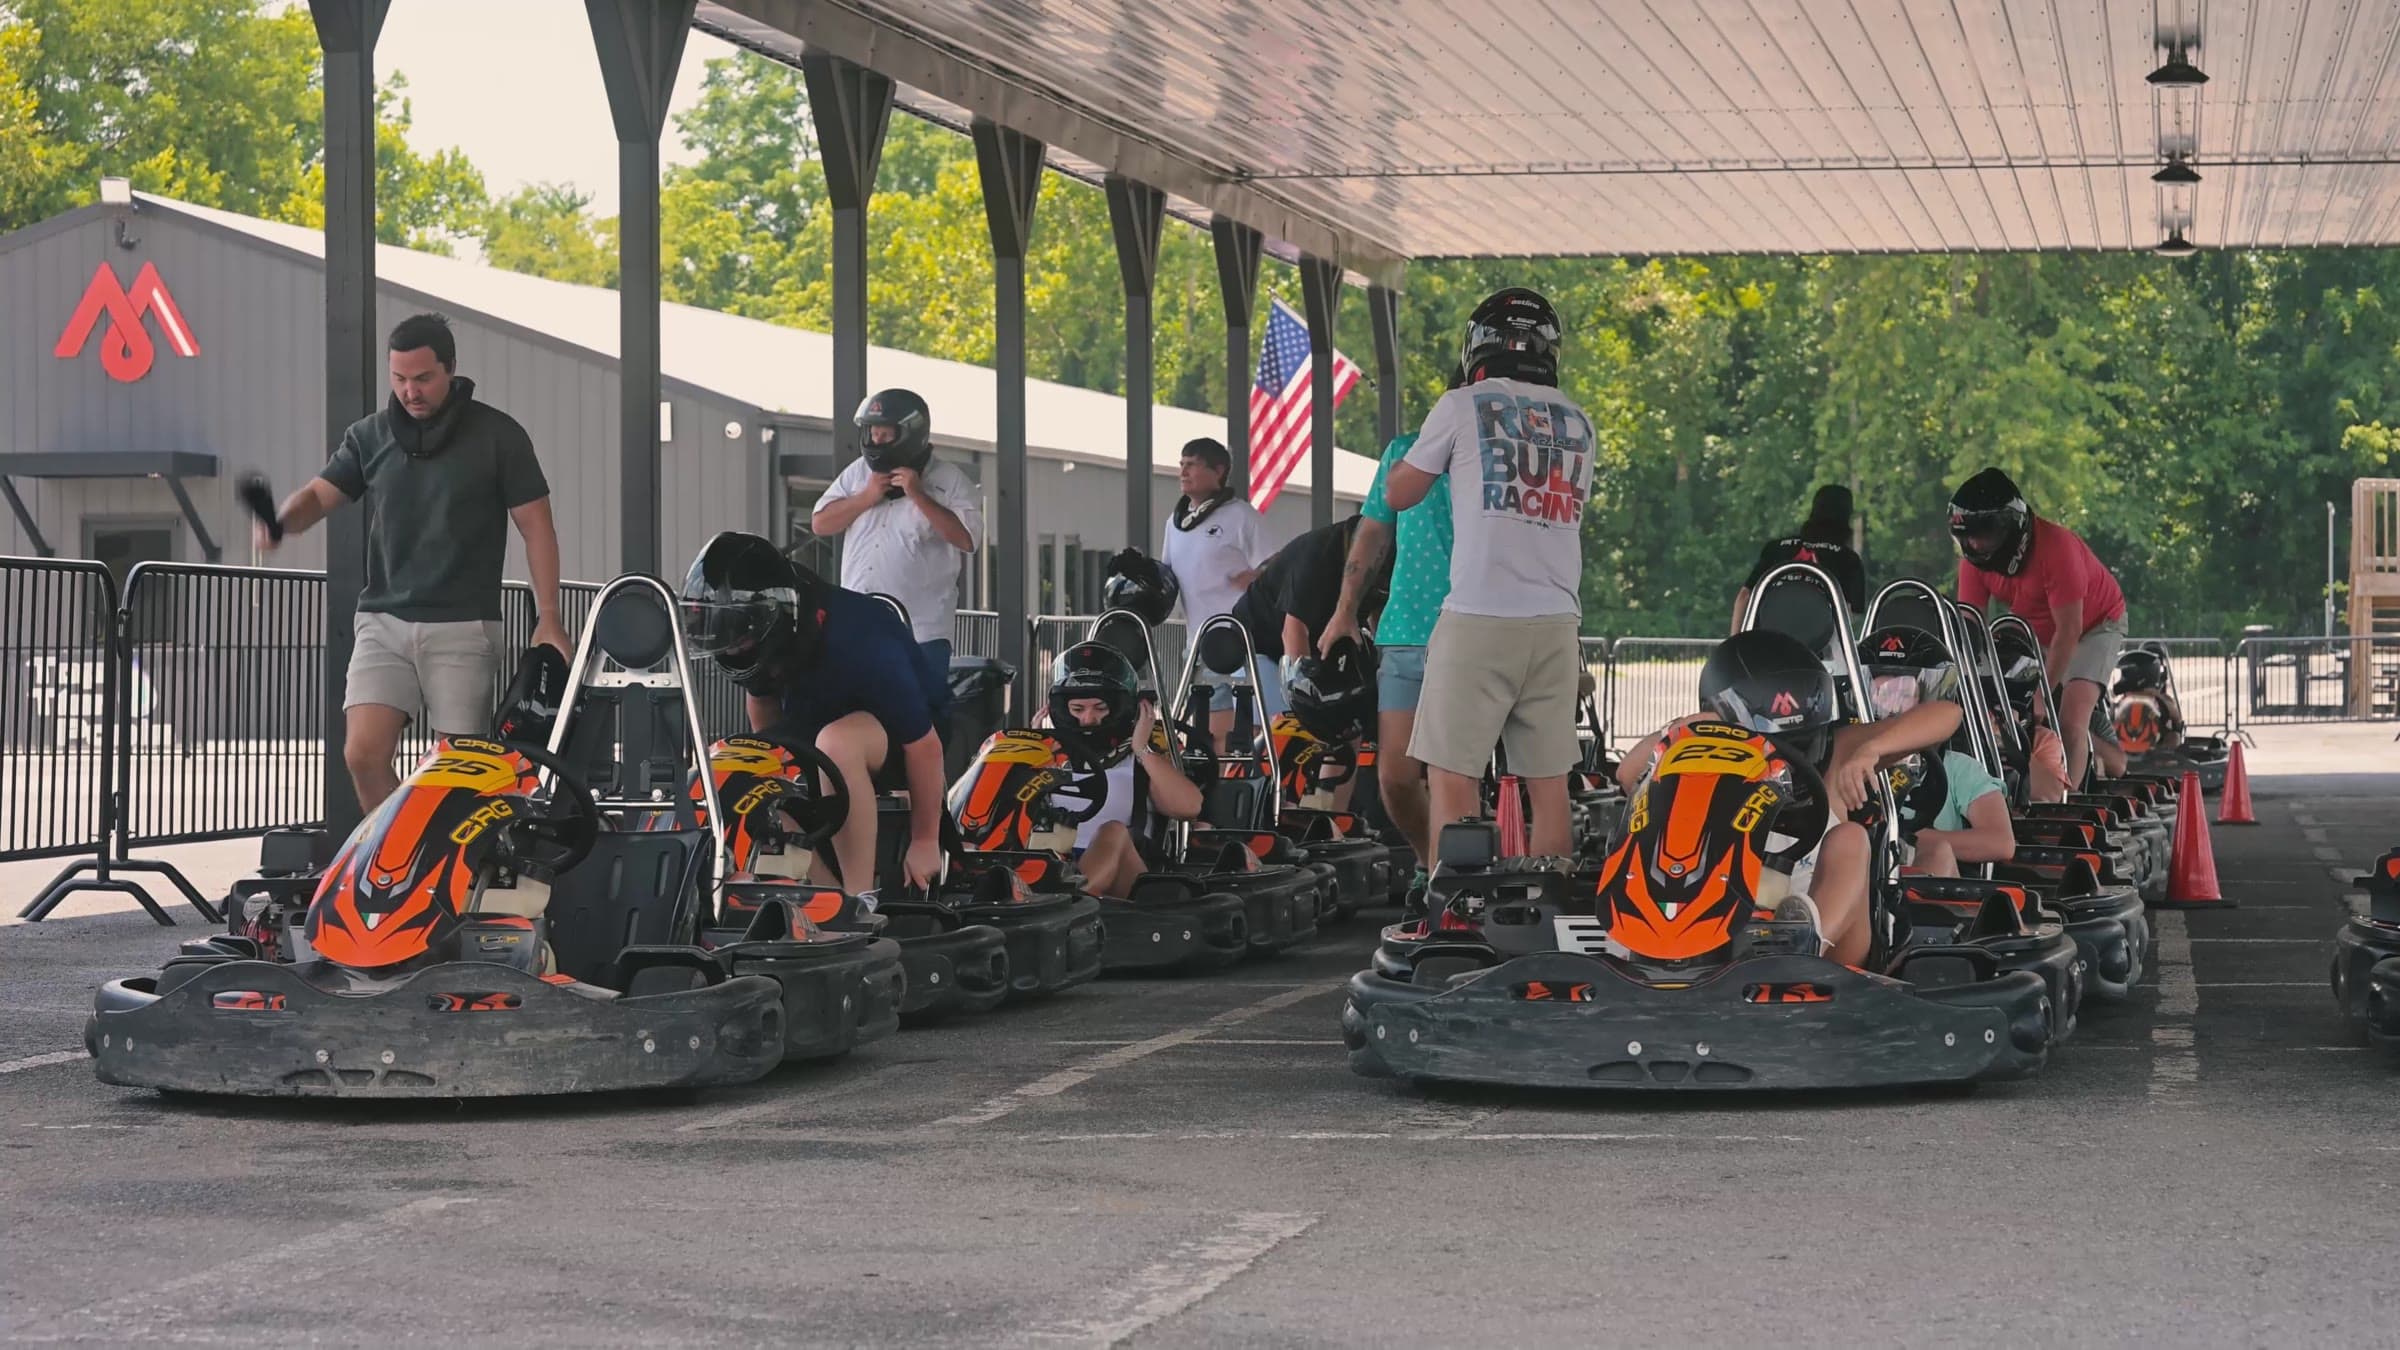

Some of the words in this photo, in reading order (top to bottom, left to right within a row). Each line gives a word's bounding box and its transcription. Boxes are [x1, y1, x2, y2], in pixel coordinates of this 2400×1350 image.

[1473, 393, 1592, 453] RED
[1480, 439, 1585, 498] BULL
[1483, 483, 1581, 524] RACING
[453, 738, 506, 754] CRG
[729, 738, 772, 750] CRG
[1695, 724, 1750, 739] CRG
[422, 757, 502, 776] 25
[1670, 744, 1755, 764] 23
[732, 779, 784, 815] CRG
[1016, 769, 1056, 802] CRG
[449, 799, 513, 845] CRG
[1731, 784, 1779, 832] CRG
